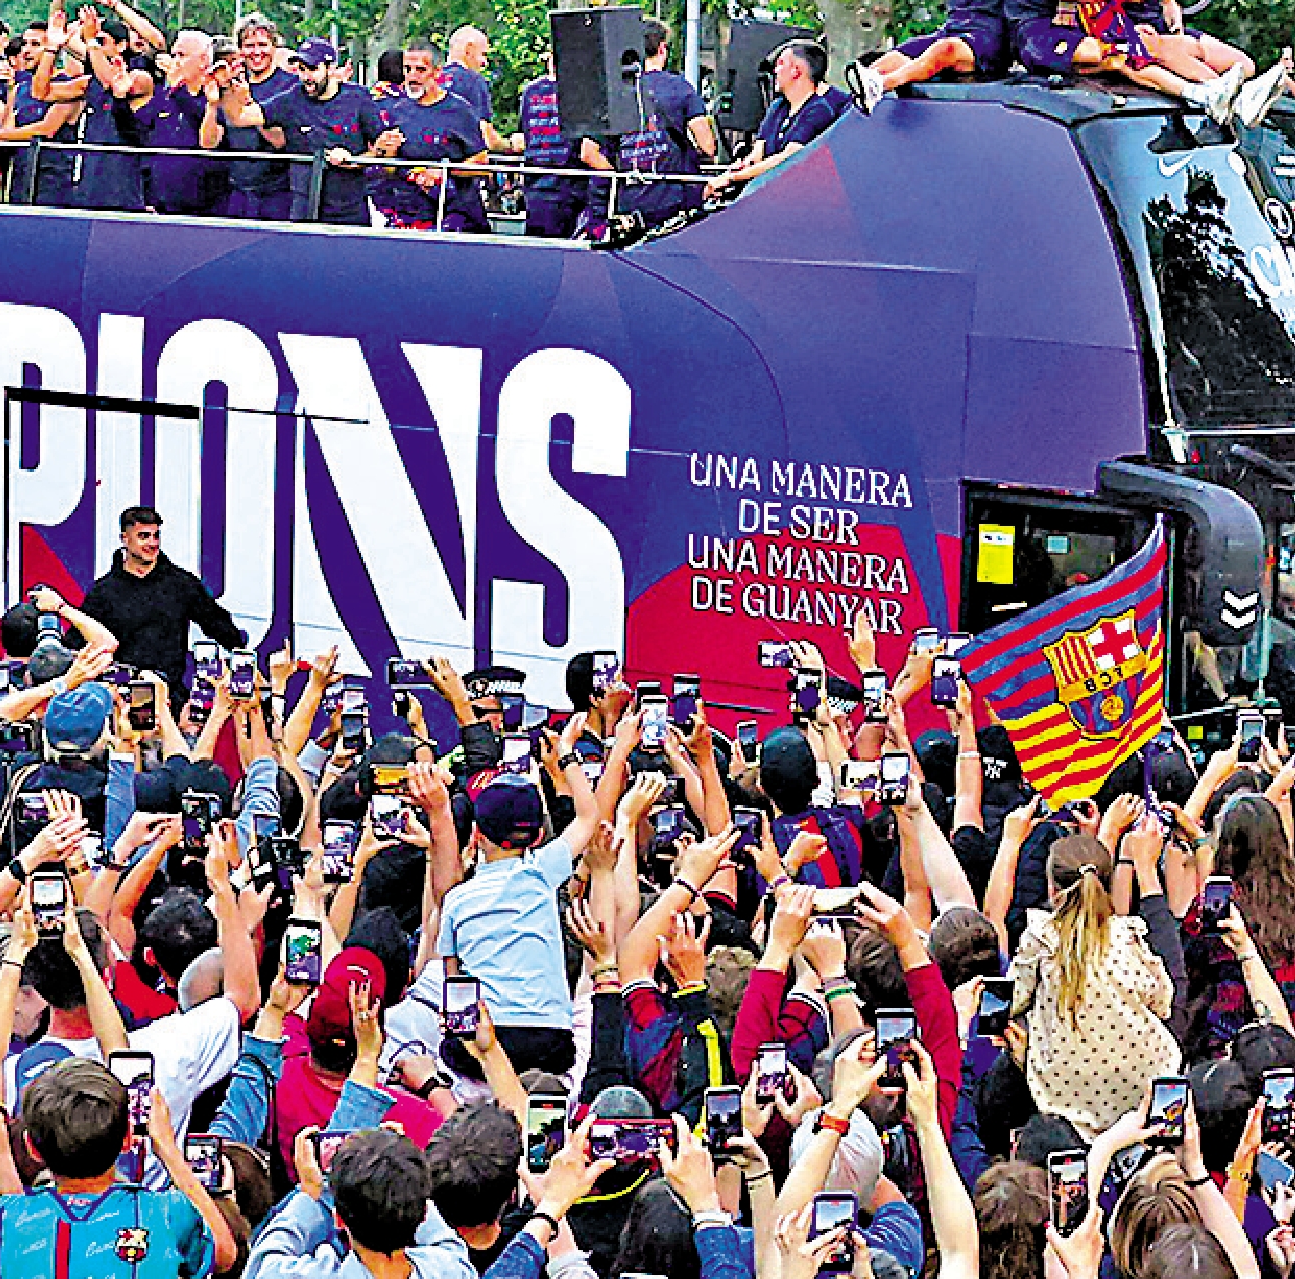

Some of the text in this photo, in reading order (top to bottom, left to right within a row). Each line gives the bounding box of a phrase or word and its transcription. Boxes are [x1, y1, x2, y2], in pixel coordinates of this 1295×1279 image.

[690, 452, 913, 508] UNA MANERA
[738, 498, 860, 546] DE SER
[688, 533, 910, 594] UNA MANERA
[691, 575, 906, 637] DE GUANYAR
